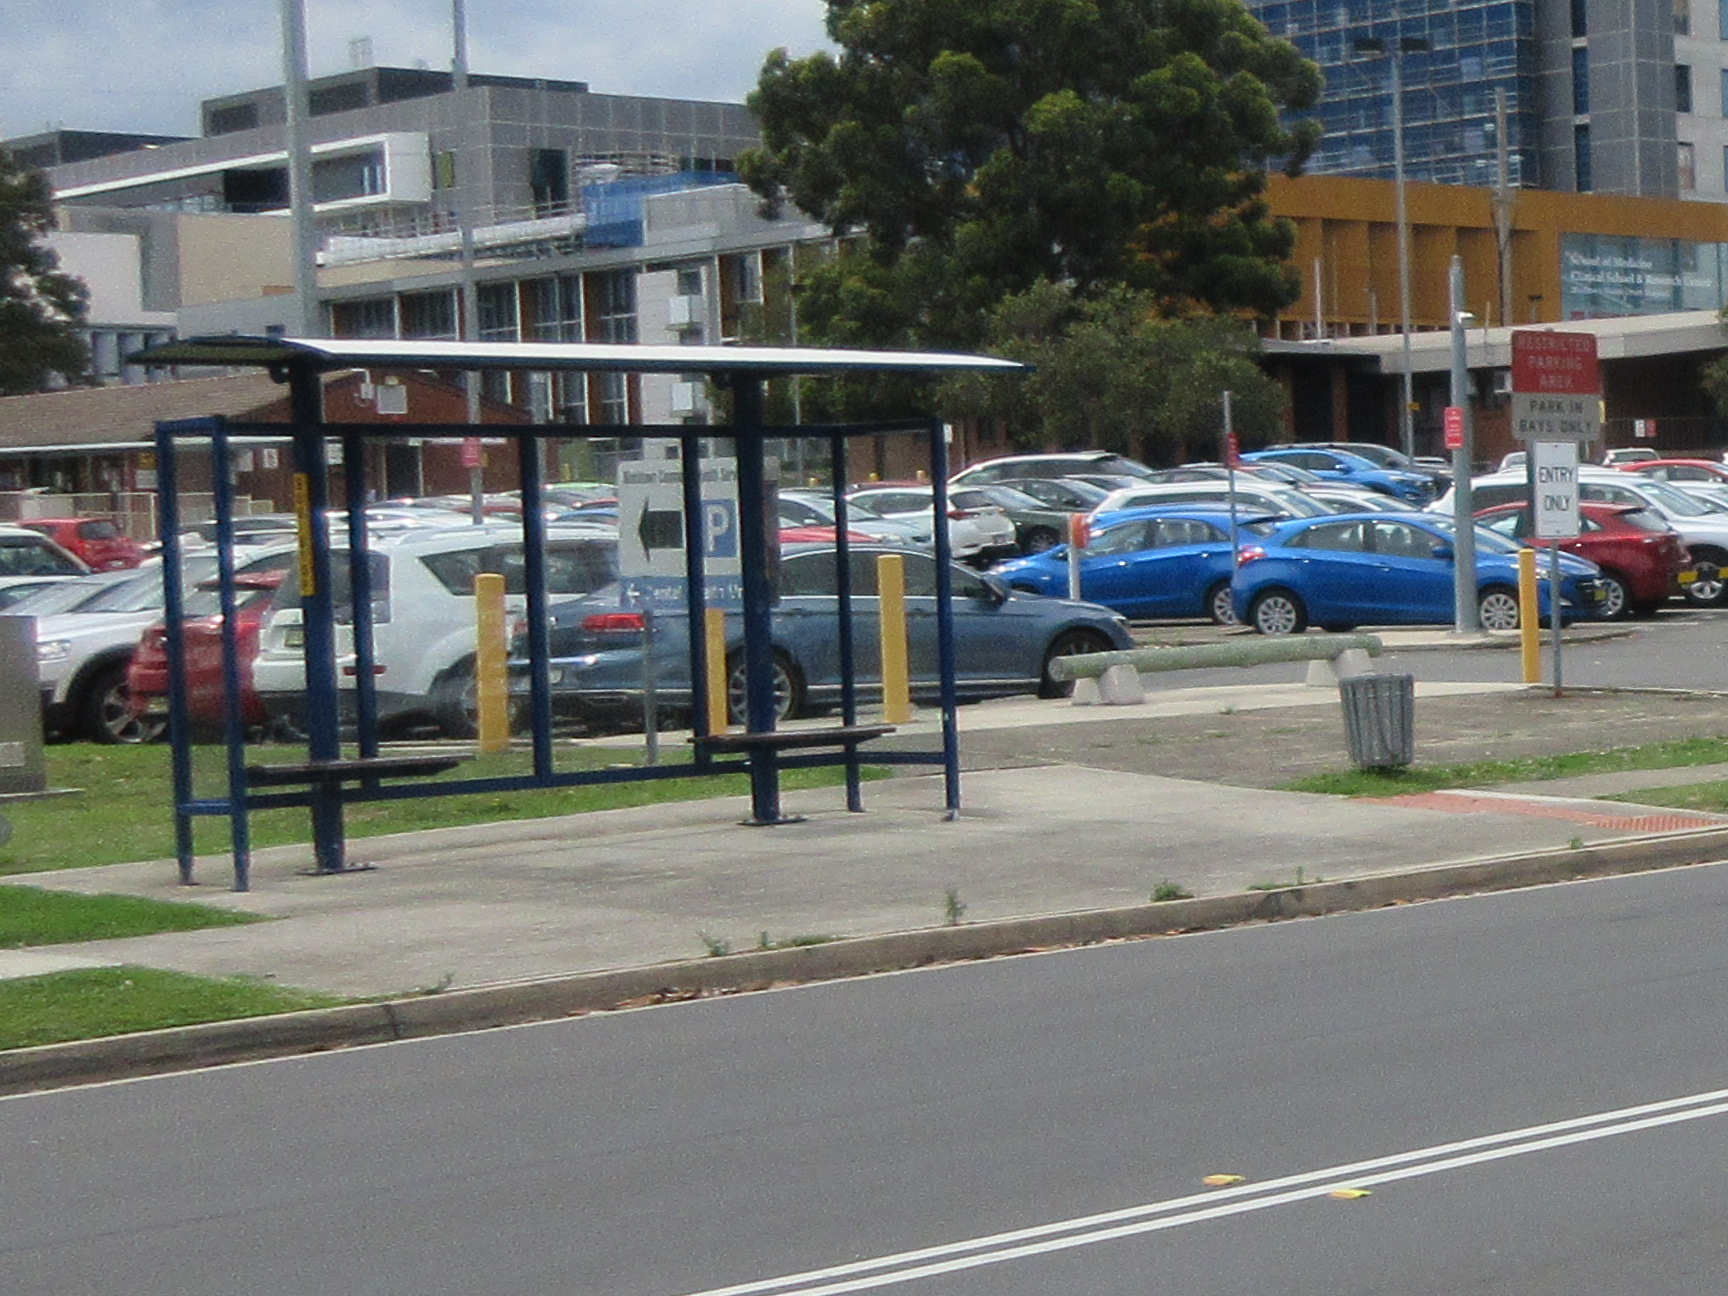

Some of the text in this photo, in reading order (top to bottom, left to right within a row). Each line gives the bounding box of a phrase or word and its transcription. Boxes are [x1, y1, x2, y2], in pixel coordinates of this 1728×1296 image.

[1518, 333, 1591, 352] RESTRICTED
[1528, 355, 1583, 371] PARKING
[1538, 374, 1574, 389] AREA
[1530, 400, 1583, 414] PARK IN
[1519, 419, 1592, 434] BAYS ONLY
[1539, 466, 1573, 484] ENTRY
[1545, 495, 1571, 512] ONLY
[707, 505, 730, 552] P
